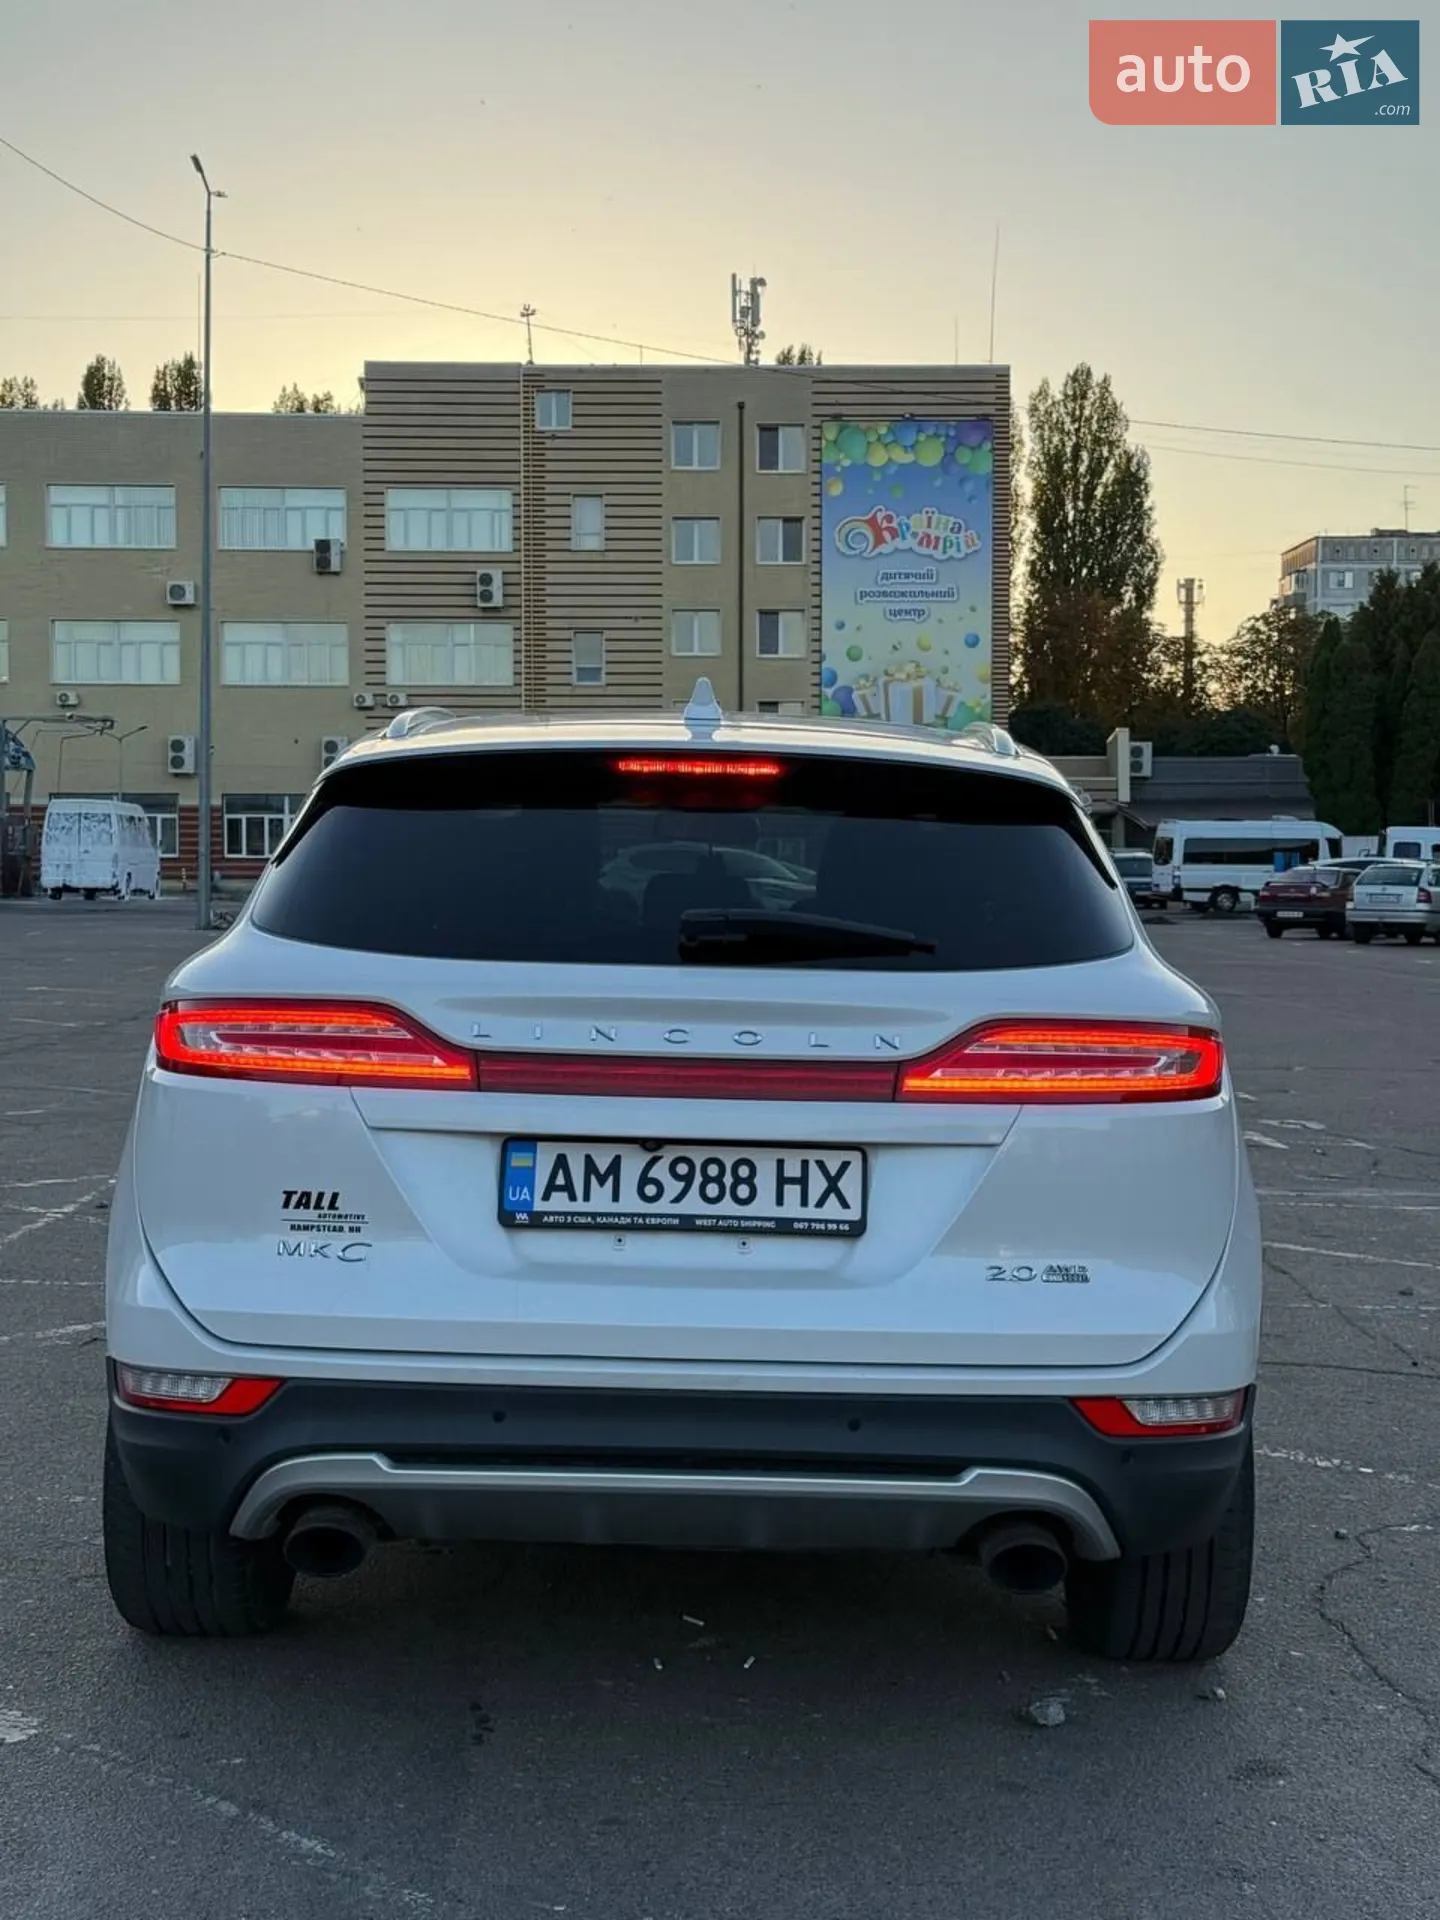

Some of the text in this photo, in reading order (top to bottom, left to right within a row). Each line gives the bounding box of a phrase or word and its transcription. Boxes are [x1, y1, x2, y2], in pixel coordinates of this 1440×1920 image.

[880, 569, 934, 581] дитячий
[859, 588, 955, 600] розважальний
[888, 607, 926, 619] центр
[471, 1022, 900, 1050] LINCOLN
[541, 1153, 852, 1209] AM 6988 HX
[282, 1190, 340, 1211] TALL
[509, 1187, 531, 1202] UA
[596, 1216, 632, 1224] КАНАДИ
[717, 1219, 738, 1227] AUTO
[740, 1220, 776, 1228] SHIPPING
[277, 1240, 372, 1262] MKC
